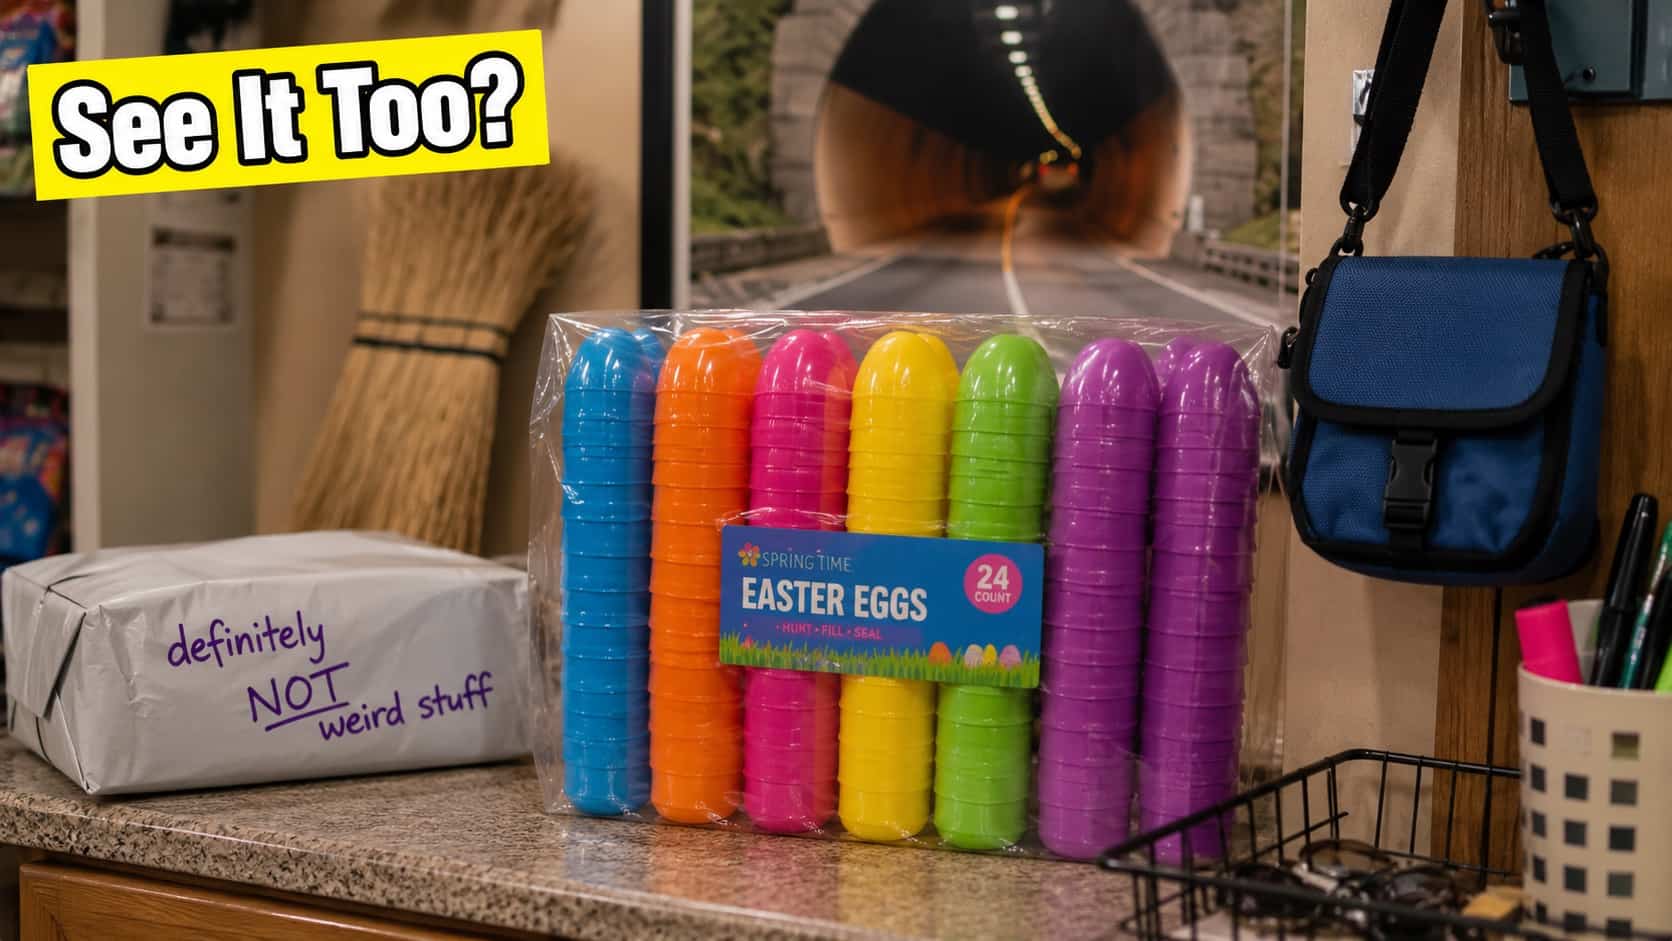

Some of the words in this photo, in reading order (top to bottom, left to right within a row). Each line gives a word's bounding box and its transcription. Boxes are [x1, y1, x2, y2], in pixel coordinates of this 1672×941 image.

[762, 551, 815, 570] SPRING
[817, 554, 853, 573] TIME
[976, 564, 1009, 590] 24
[741, 577, 846, 617] EASTER
[853, 584, 928, 622] EGGS
[974, 591, 1012, 603] COUNT
[167, 611, 326, 668] definitely
[820, 625, 844, 637] FILL
[854, 628, 883, 640] SEAL
[247, 662, 350, 731] NOT
[319, 691, 405, 741] weird
[418, 671, 494, 719] stuff
